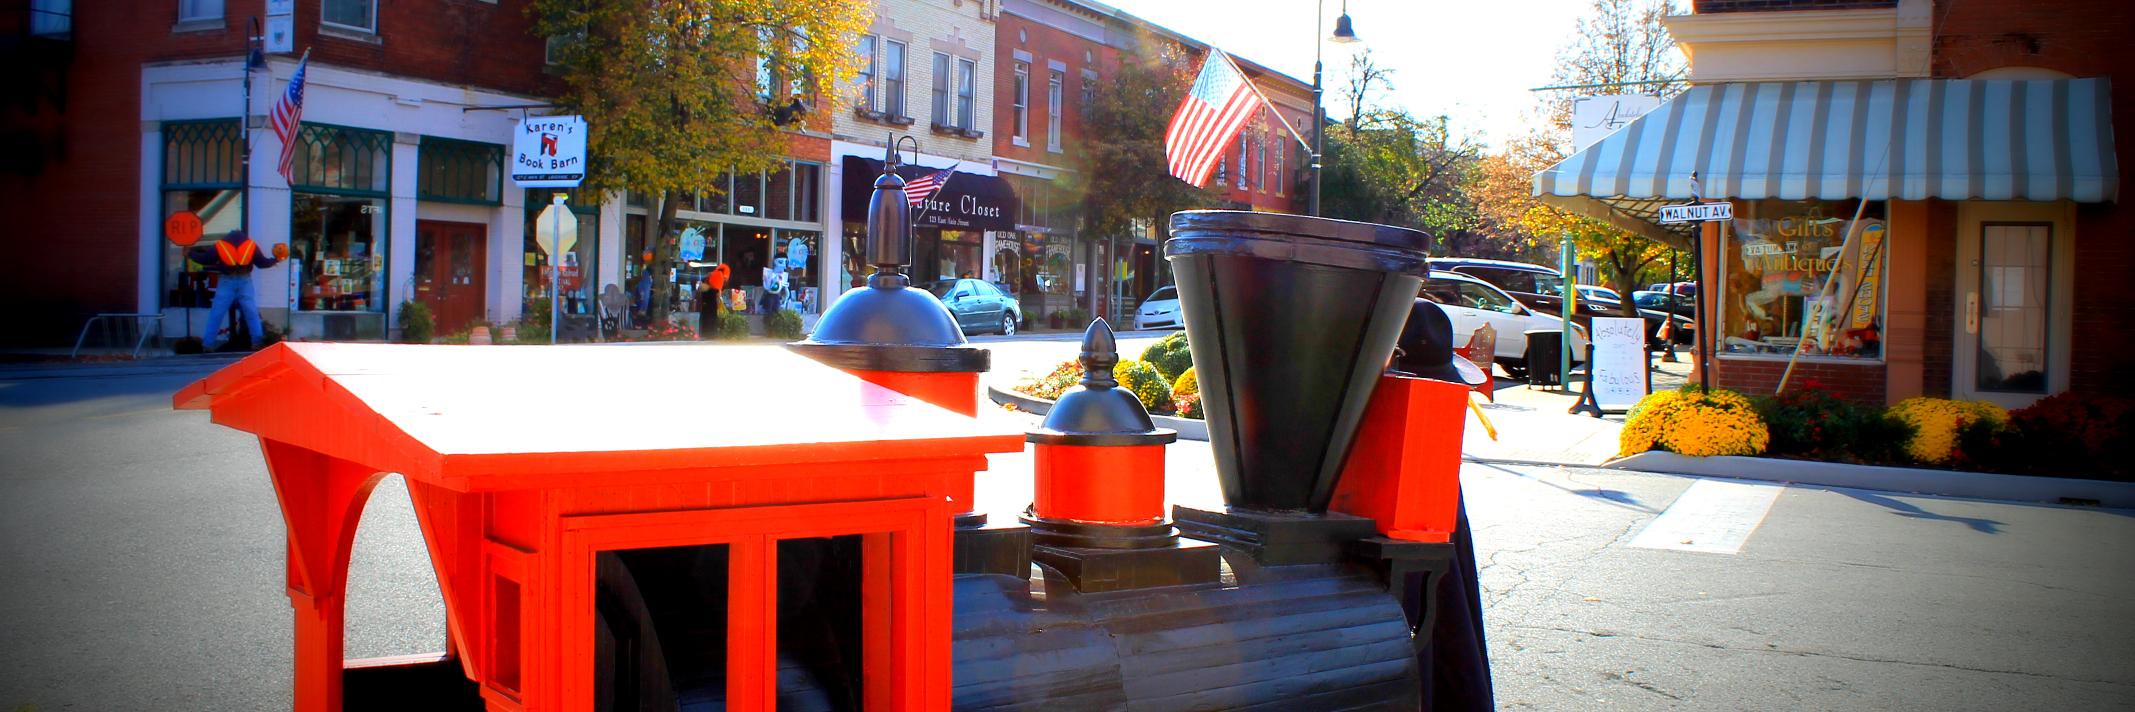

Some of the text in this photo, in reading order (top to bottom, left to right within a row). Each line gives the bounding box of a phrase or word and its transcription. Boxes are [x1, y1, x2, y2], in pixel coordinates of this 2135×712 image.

[525, 122, 573, 135] Karen's
[519, 152, 578, 170] Book Barn
[961, 194, 1000, 218] Closet
[1665, 206, 1709, 220] WALNUT
[171, 219, 198, 235] RIP
[1777, 210, 1835, 238] Gifts
[1754, 252, 1853, 279] Antiques
